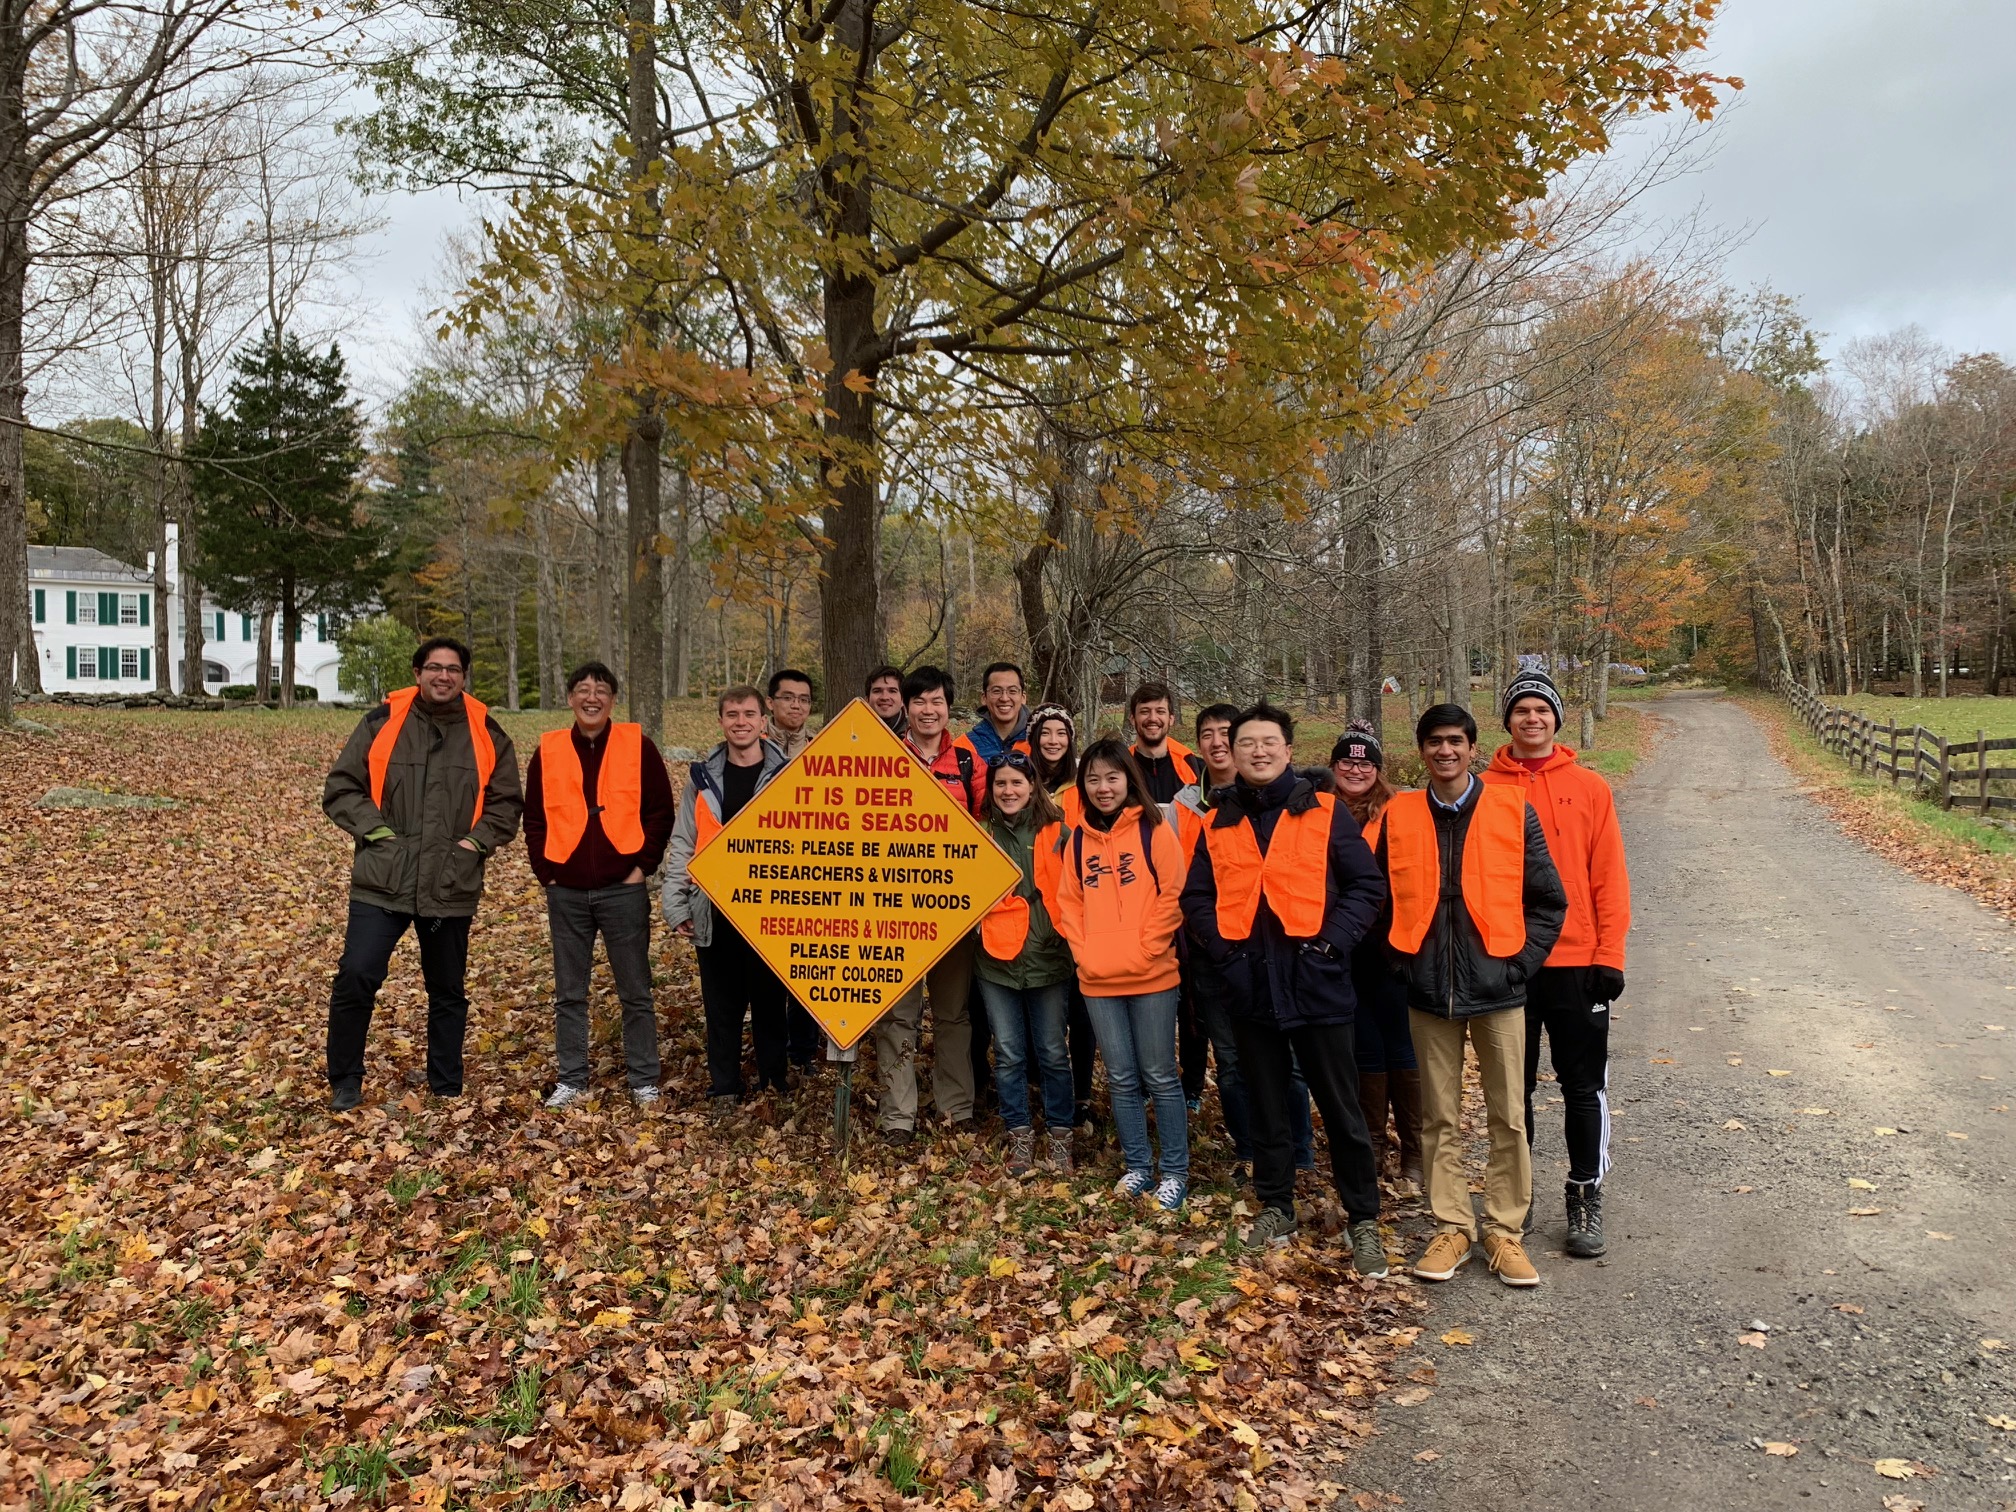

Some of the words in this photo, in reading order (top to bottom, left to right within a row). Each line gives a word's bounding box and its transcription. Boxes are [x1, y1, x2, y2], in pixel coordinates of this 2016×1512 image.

[1349, 744, 1366, 758] H
[802, 754, 910, 779] WARNING
[794, 786, 814, 806] IT
[824, 786, 844, 806] IS
[855, 787, 913, 807] DEER
[757, 810, 850, 831] HUNTING
[861, 812, 949, 833] SEASON
[726, 838, 796, 855] HUNTERS:
[801, 840, 855, 857] PLEASE
[861, 841, 881, 858] BE
[886, 842, 936, 859] AWARE
[942, 843, 979, 860] THAT
[748, 863, 865, 883] RESEARCHERS
[867, 866, 879, 883] &
[881, 867, 954, 885] VISITORS
[730, 887, 763, 904] ARE
[770, 889, 843, 907] PRESENT
[849, 891, 865, 907] IN
[872, 892, 904, 908] THE
[911, 893, 971, 911] WOODS
[760, 916, 859, 939] RESEARCHERS
[862, 918, 872, 939] &
[875, 919, 938, 942] VISITORS
[789, 942, 850, 960] PLEASE
[857, 944, 905, 962] WEAR
[789, 963, 837, 981] BRIGHT
[841, 965, 904, 984] COLORED
[809, 985, 882, 1005] CLOTHES
